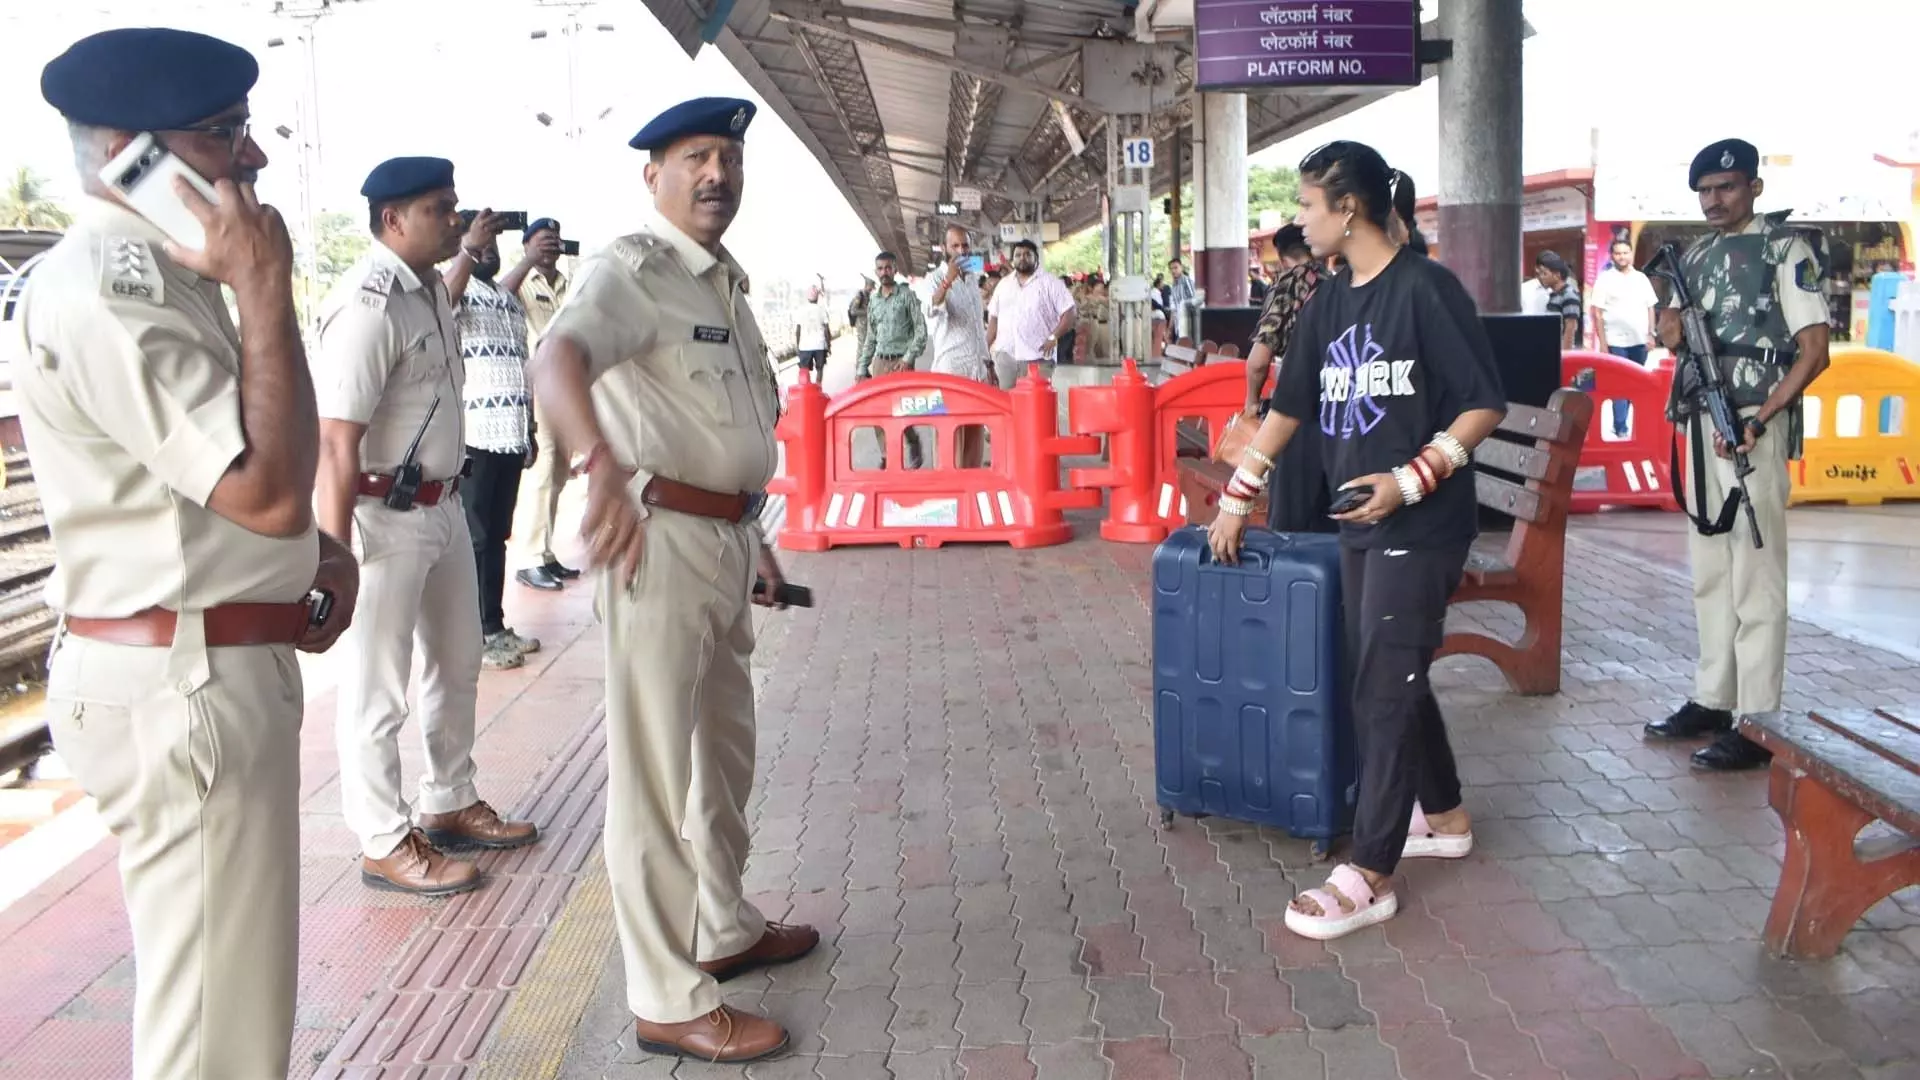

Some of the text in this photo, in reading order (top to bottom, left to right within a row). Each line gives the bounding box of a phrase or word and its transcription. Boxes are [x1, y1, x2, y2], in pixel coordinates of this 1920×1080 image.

[1322, 4, 1353, 23] नंबर
[1260, 30, 1354, 50] प्लेटफॉर्म नंबर
[1248, 60, 1366, 76] PLATFORM NO.
[1127, 141, 1150, 163] 18
[901, 396, 938, 411] RPF
[1825, 464, 1878, 482] Swift
